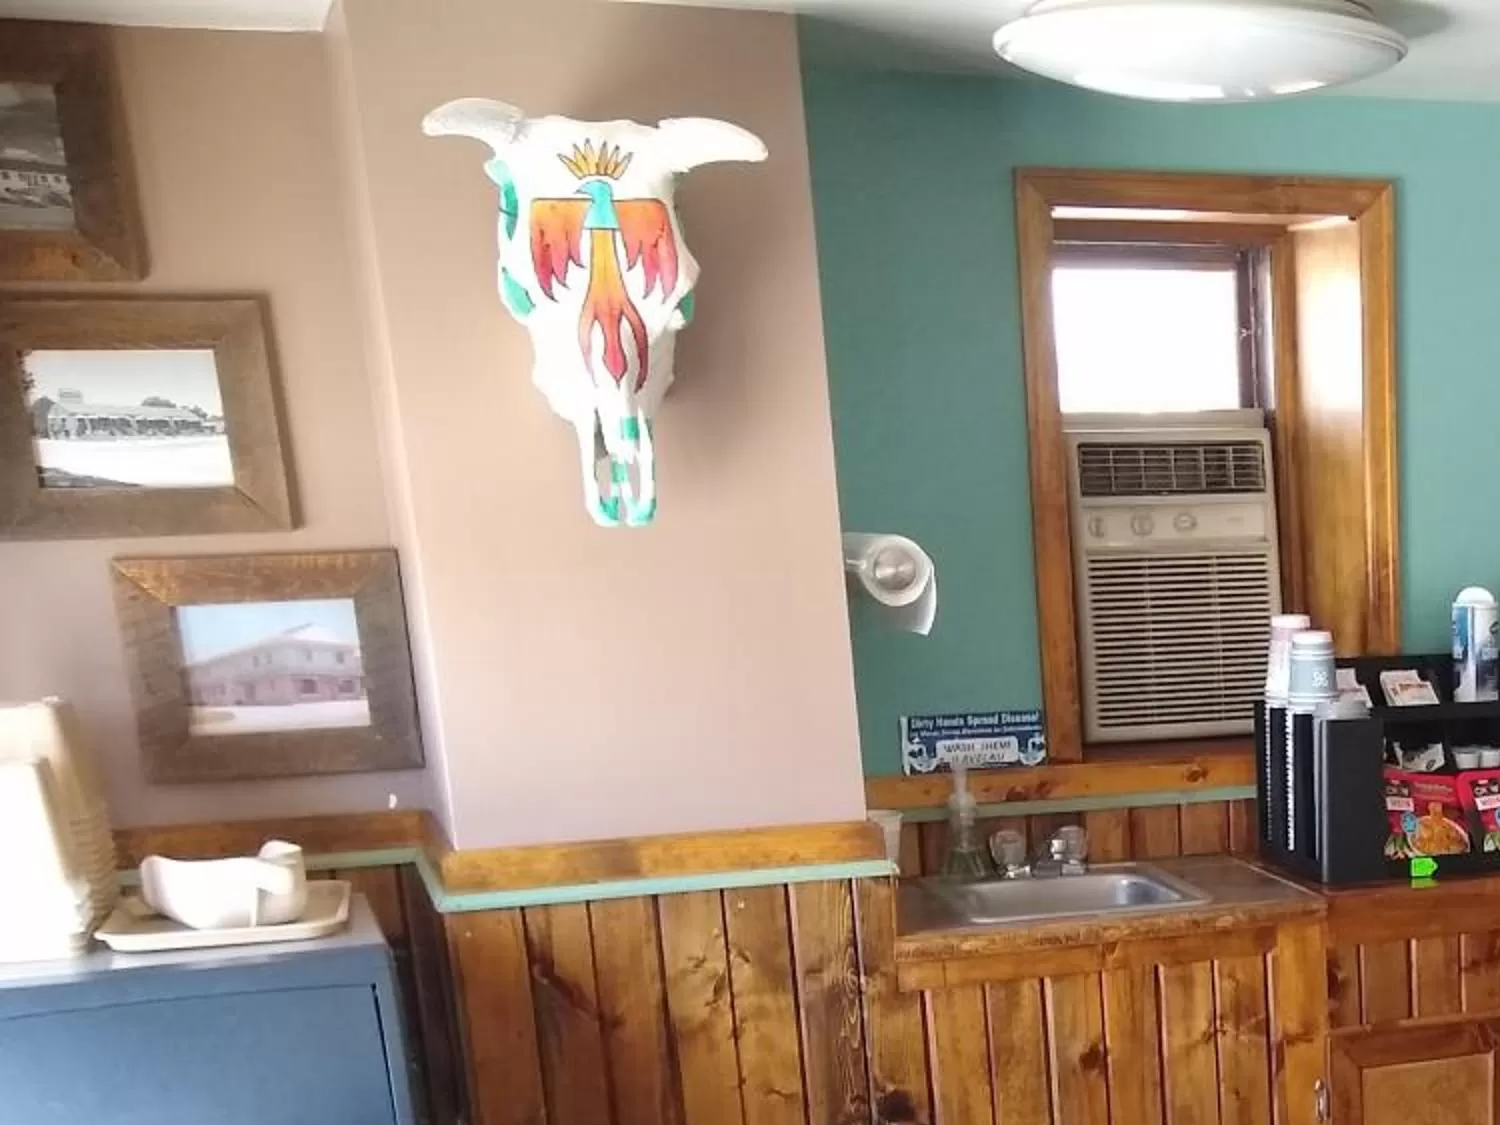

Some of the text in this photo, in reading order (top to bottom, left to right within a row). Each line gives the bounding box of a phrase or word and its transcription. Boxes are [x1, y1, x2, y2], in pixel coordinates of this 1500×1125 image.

[911, 718, 934, 730] Dirty
[936, 716, 964, 727] Hands
[967, 714, 998, 727] Spread
